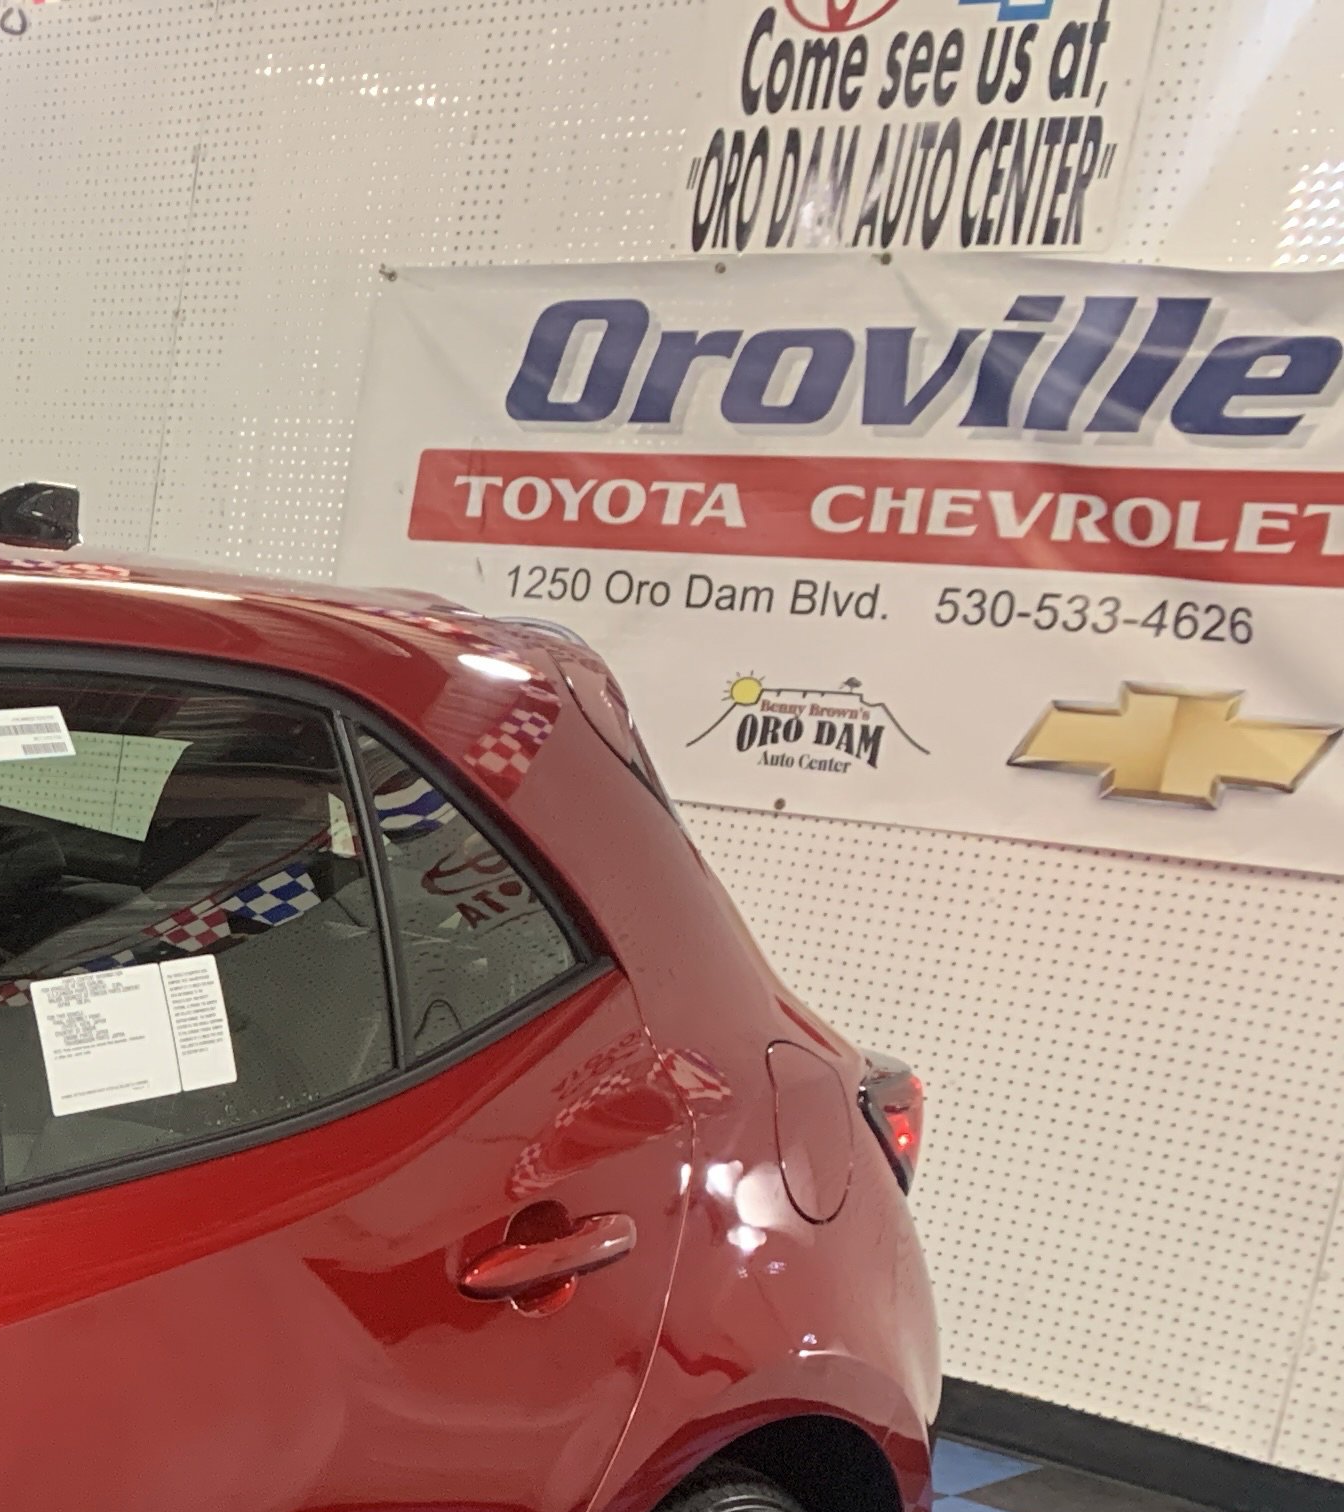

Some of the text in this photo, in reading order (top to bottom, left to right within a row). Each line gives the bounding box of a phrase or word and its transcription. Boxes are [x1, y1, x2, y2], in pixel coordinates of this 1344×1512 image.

[741, 0, 1111, 116] Come see us at,
[686, 114, 1118, 252] "ORO DAM AUTO CENTER"
[503, 294, 1344, 440] Oroville
[453, 474, 1344, 556] TOYOTA CHEVROLET
[505, 563, 1254, 645] 1250 Oro Dam Blvd. 530-533-4626
[736, 713, 885, 769] ORO DAM
[760, 699, 870, 721] Benny Brown's
[758, 750, 852, 773] Auto Center
